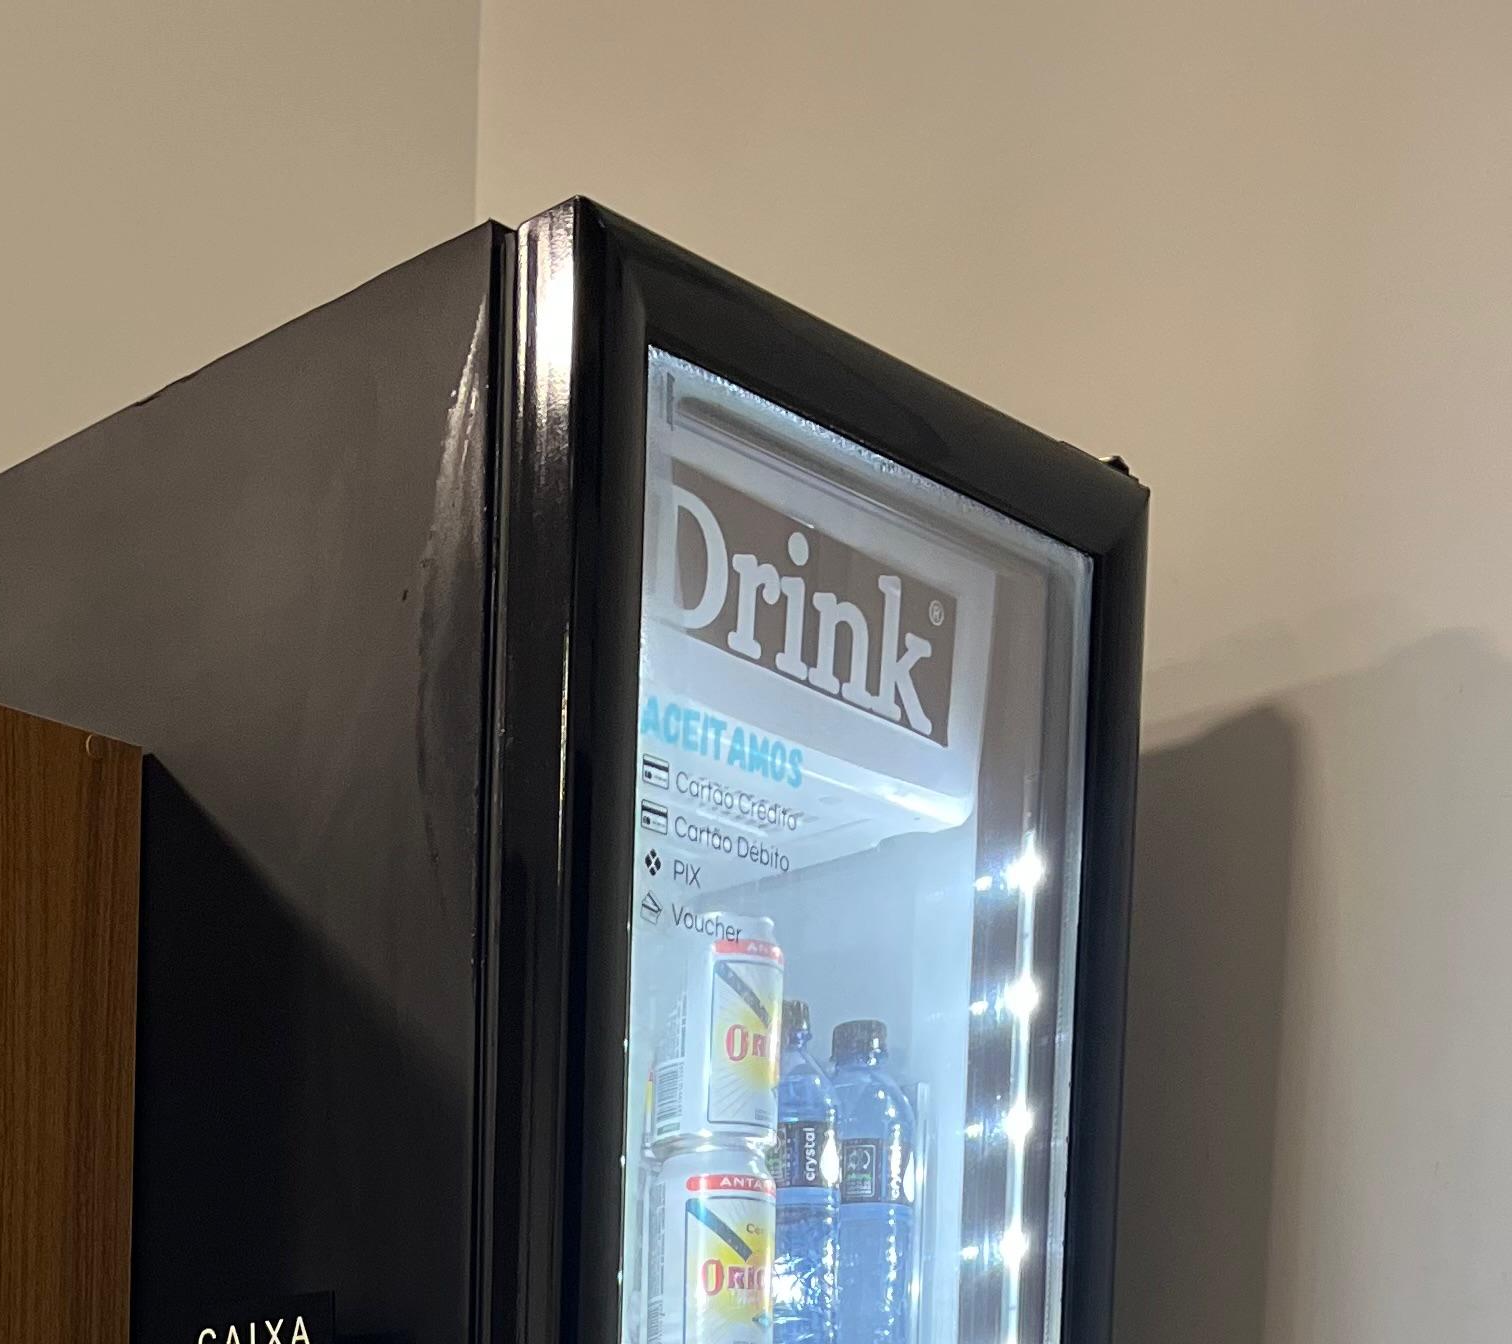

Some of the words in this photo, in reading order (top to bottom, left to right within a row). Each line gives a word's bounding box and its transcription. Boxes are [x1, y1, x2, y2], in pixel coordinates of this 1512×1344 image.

[654, 484, 932, 735] Drink
[640, 697, 804, 789] ACEITAMOS
[675, 771, 734, 810] Cartão
[738, 791, 797, 831] Crédito
[674, 816, 733, 854] Cartão
[738, 836, 790, 873] Débito
[673, 860, 702, 889] PIX
[672, 903, 743, 943] Voucher
[803, 1127, 817, 1182] crystal
